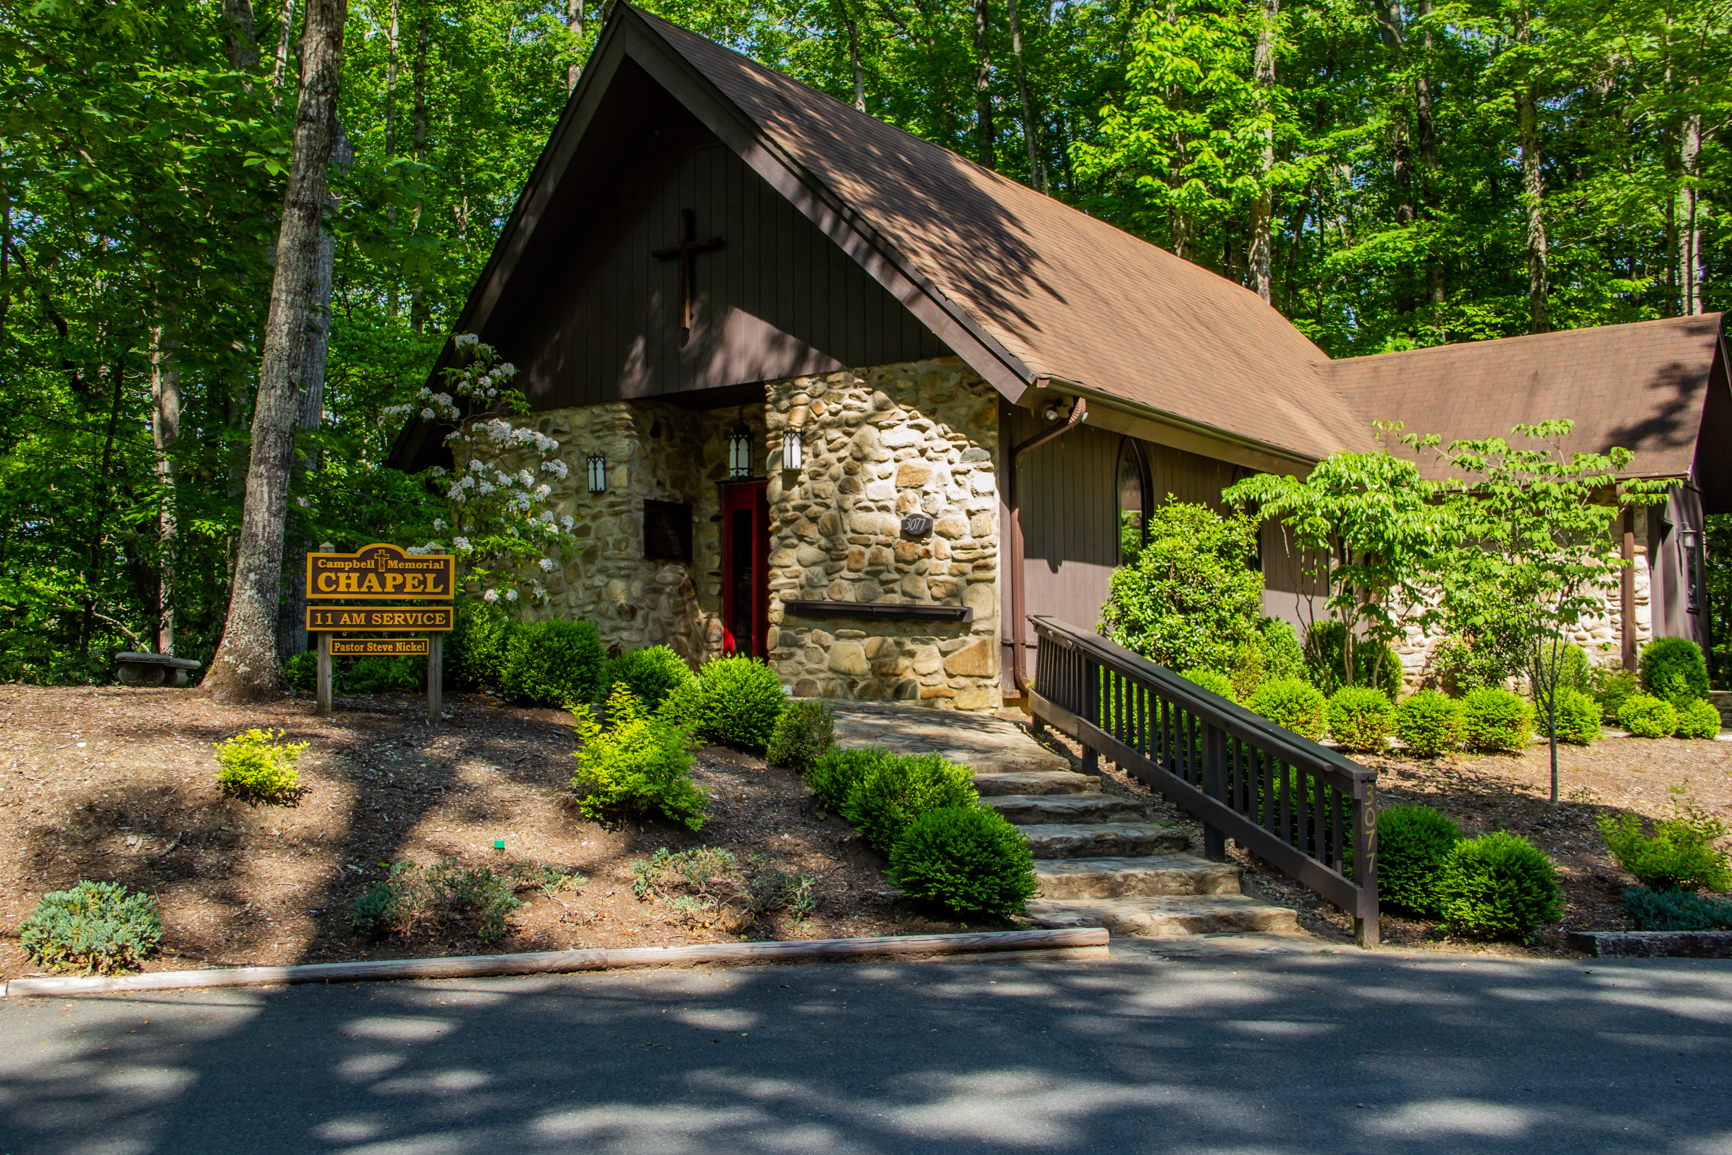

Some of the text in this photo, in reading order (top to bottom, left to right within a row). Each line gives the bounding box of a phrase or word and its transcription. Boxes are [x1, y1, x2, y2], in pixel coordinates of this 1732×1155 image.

[904, 517, 926, 531] 3077
[317, 559, 444, 570] Campbell Memorial
[317, 572, 444, 593] CHAPEL
[315, 613, 446, 625] 11 AM SERVICE
[334, 642, 425, 652] Pastor Steve Nickel
[1364, 784, 1376, 874] 3077
